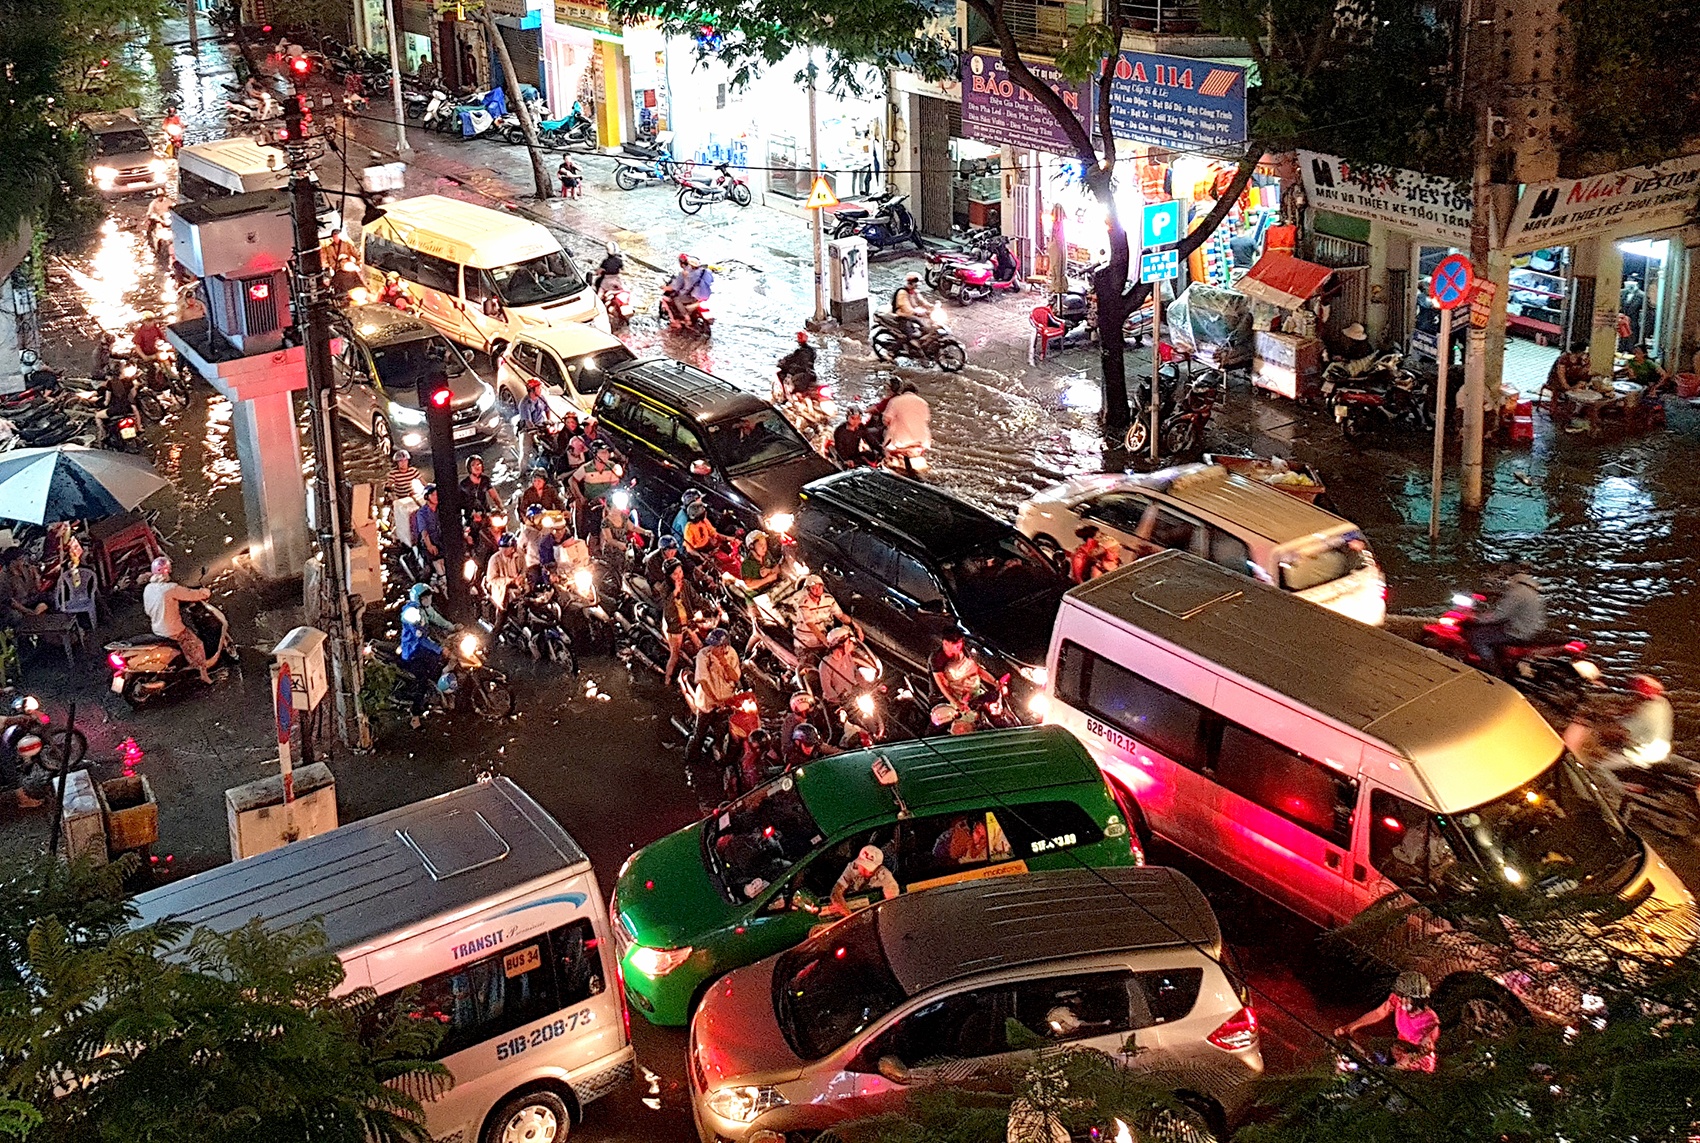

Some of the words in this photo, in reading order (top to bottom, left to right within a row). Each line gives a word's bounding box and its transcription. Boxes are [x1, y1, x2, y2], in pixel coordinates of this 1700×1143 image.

[972, 72, 1013, 98] BẢO
[1155, 64, 1194, 89] 114
[980, 105, 990, 113] Pha
[1019, 112, 1030, 121] Pha
[1087, 719, 1136, 755] 62B-012.12
[451, 929, 505, 960] TRANSIT
[506, 955, 525, 971] BUS
[528, 949, 538, 964] 34
